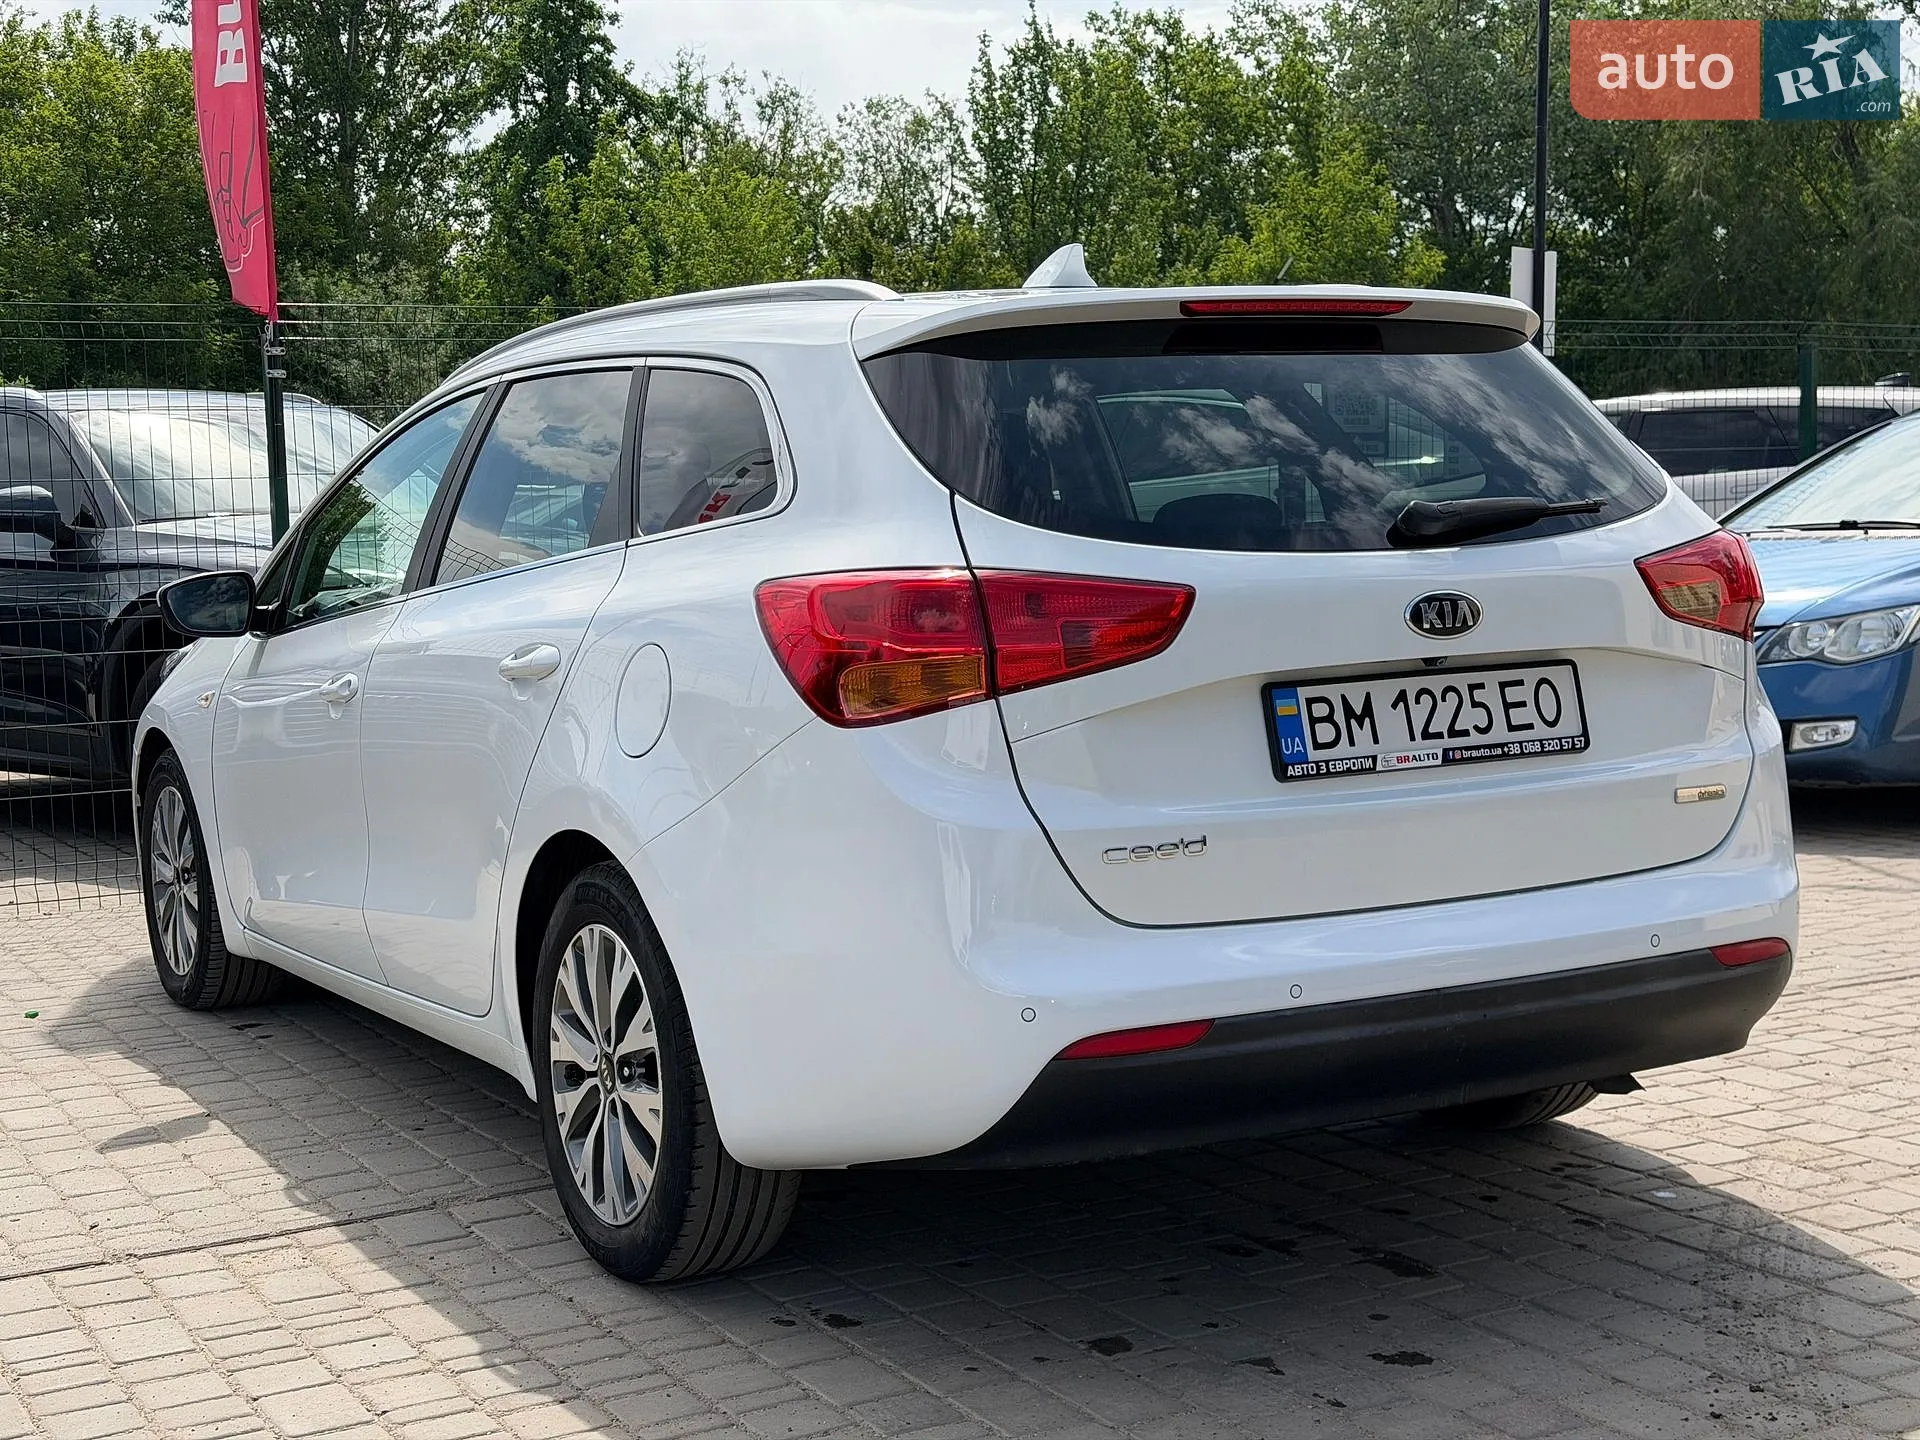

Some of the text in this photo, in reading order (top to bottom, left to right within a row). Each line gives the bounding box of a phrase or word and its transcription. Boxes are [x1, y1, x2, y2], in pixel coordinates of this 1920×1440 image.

[1419, 600, 1474, 629] KIA
[1304, 691, 1380, 751] BM
[1390, 682, 1495, 743] 1225
[1281, 737, 1304, 754] UA
[1462, 737, 1586, 758] brauto.ua +38 068 320 57 57
[1396, 753, 1439, 764] BRAUTO
